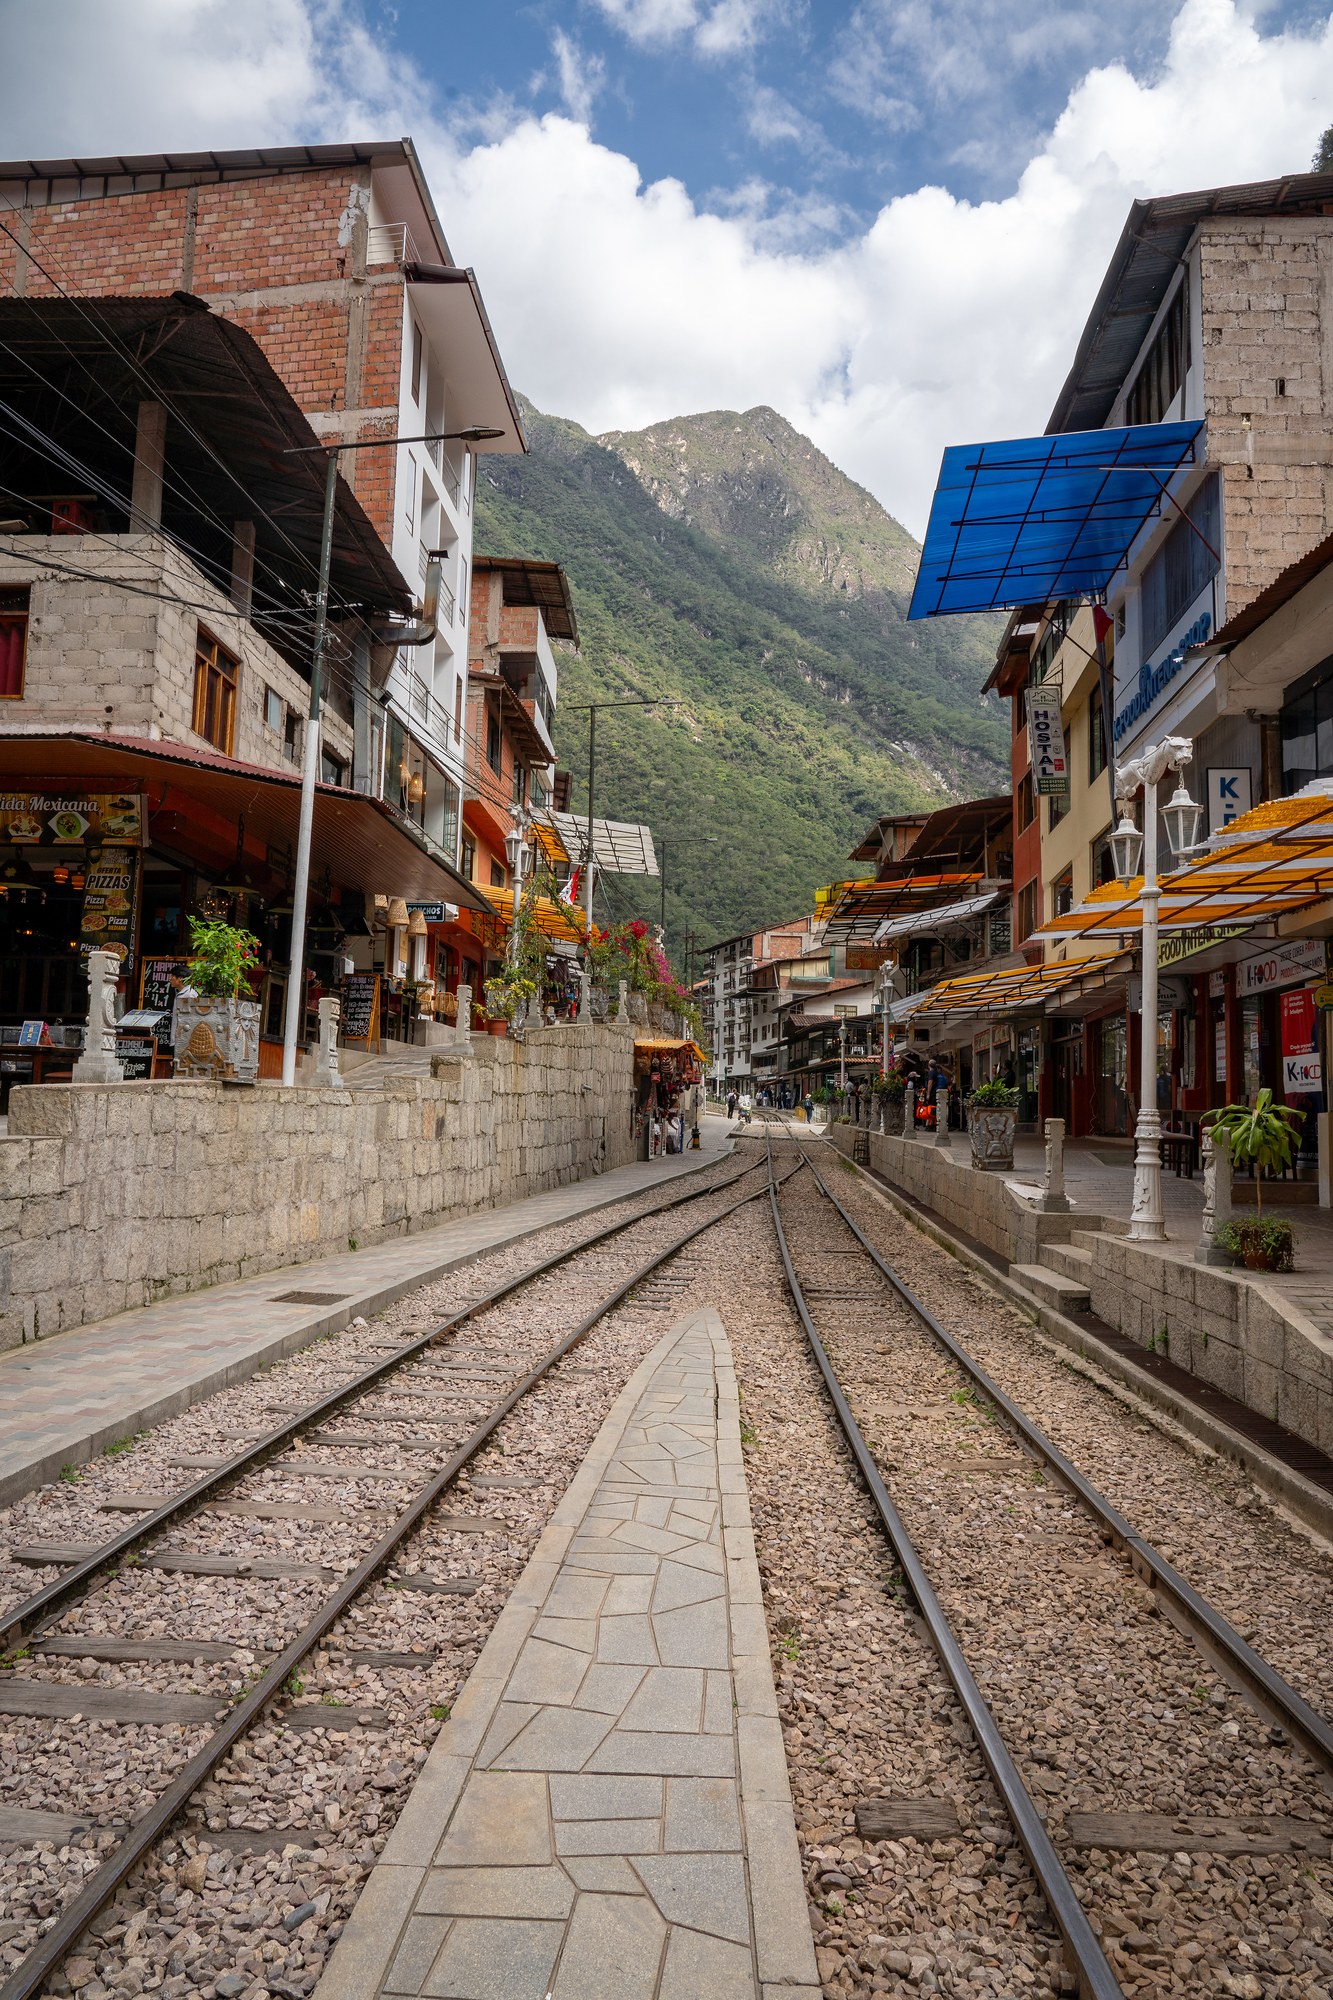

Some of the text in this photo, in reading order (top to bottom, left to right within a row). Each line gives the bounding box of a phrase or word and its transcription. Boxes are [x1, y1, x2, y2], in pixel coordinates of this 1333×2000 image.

[1034, 710, 1054, 777] HOSTAL
[29, 796, 100, 812] Mexicana
[86, 874, 131, 890] PIZZAS
[85, 895, 105, 904] Pizza
[108, 916, 128, 925] Pizza
[80, 943, 105, 952] Pizza
[153, 962, 177, 972] HAPP
[1247, 960, 1278, 988] K-FOOD
[151, 981, 171, 994] 2x1
[1286, 1061, 1322, 1082] K-FOOD
